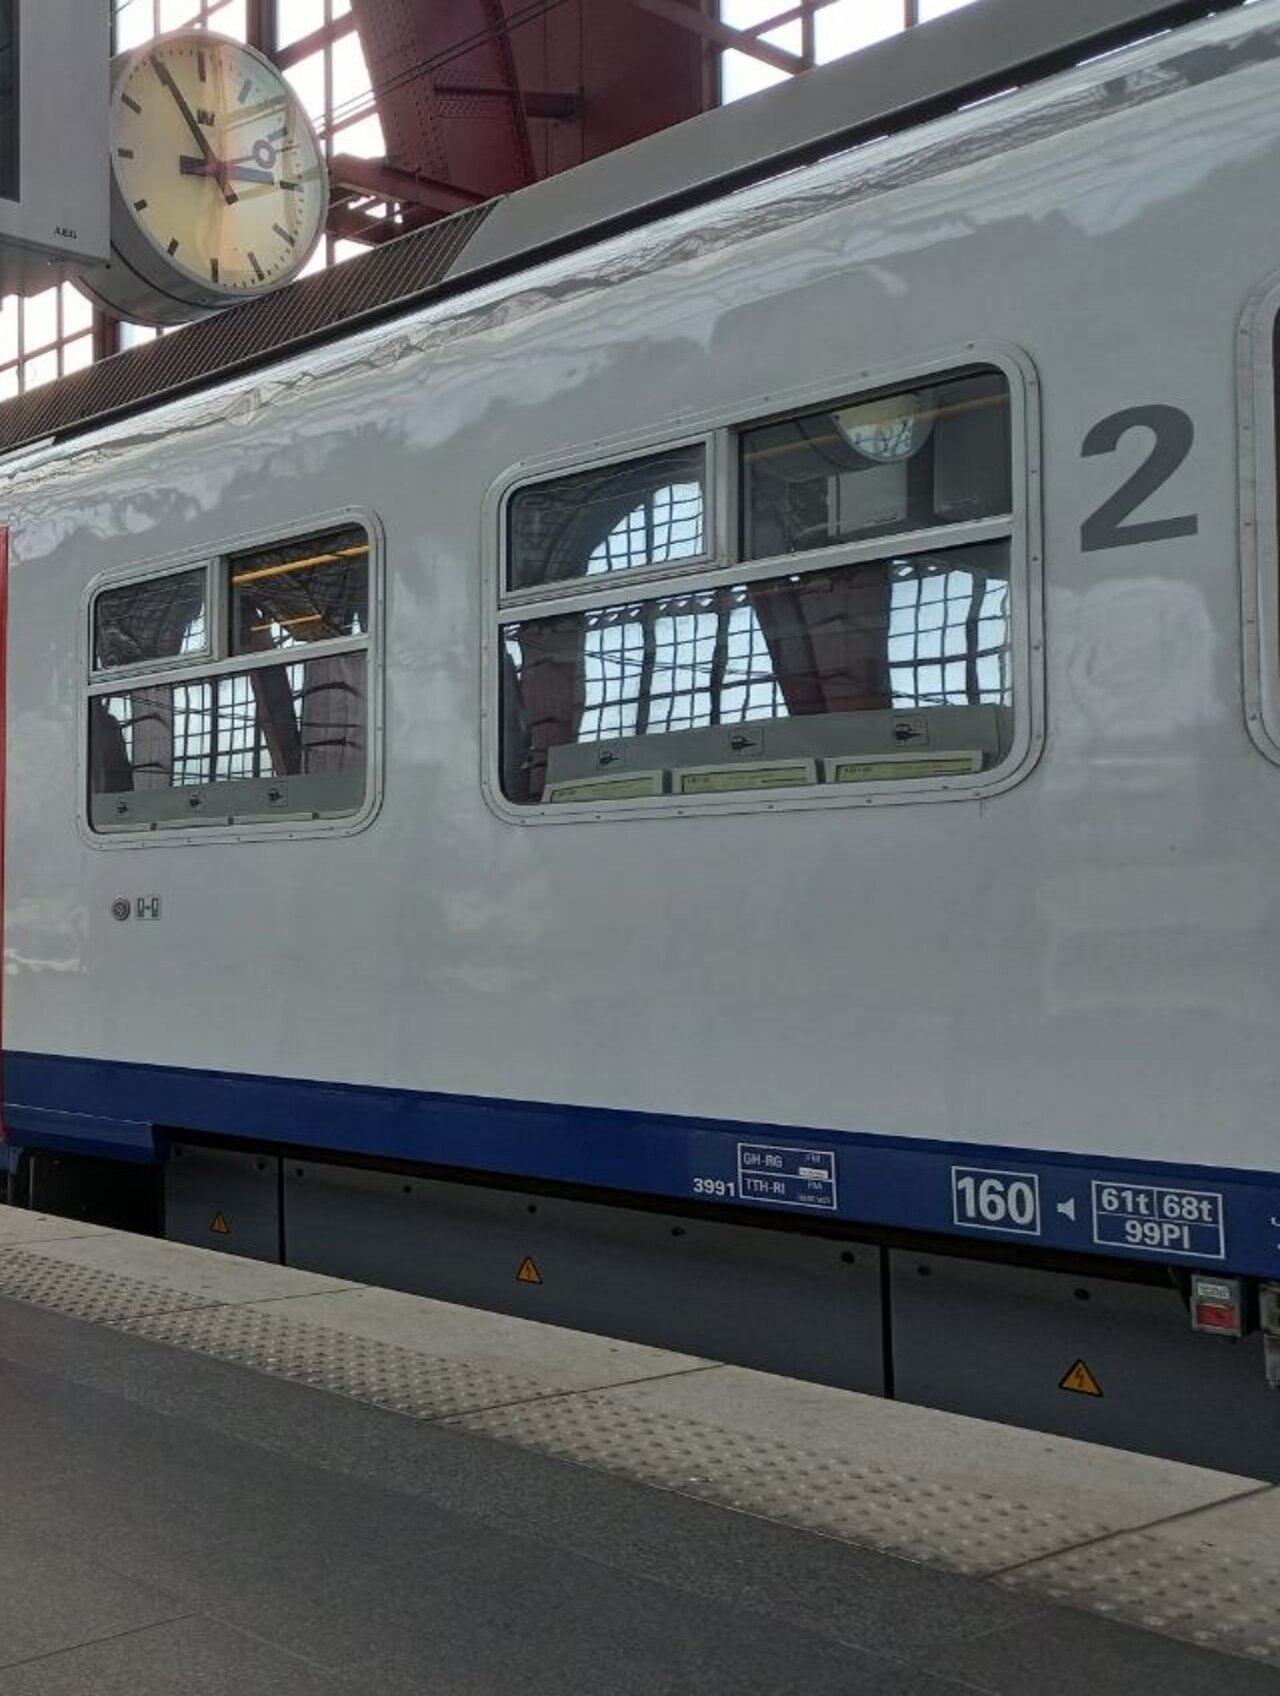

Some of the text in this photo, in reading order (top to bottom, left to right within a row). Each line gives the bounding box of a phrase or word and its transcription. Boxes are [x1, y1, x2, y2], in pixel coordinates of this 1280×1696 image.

[1081, 404, 1199, 552] 2
[693, 1177, 735, 1197] 3991
[957, 1176, 1035, 1225] 160
[1101, 1187, 1213, 1222] 61t 68t
